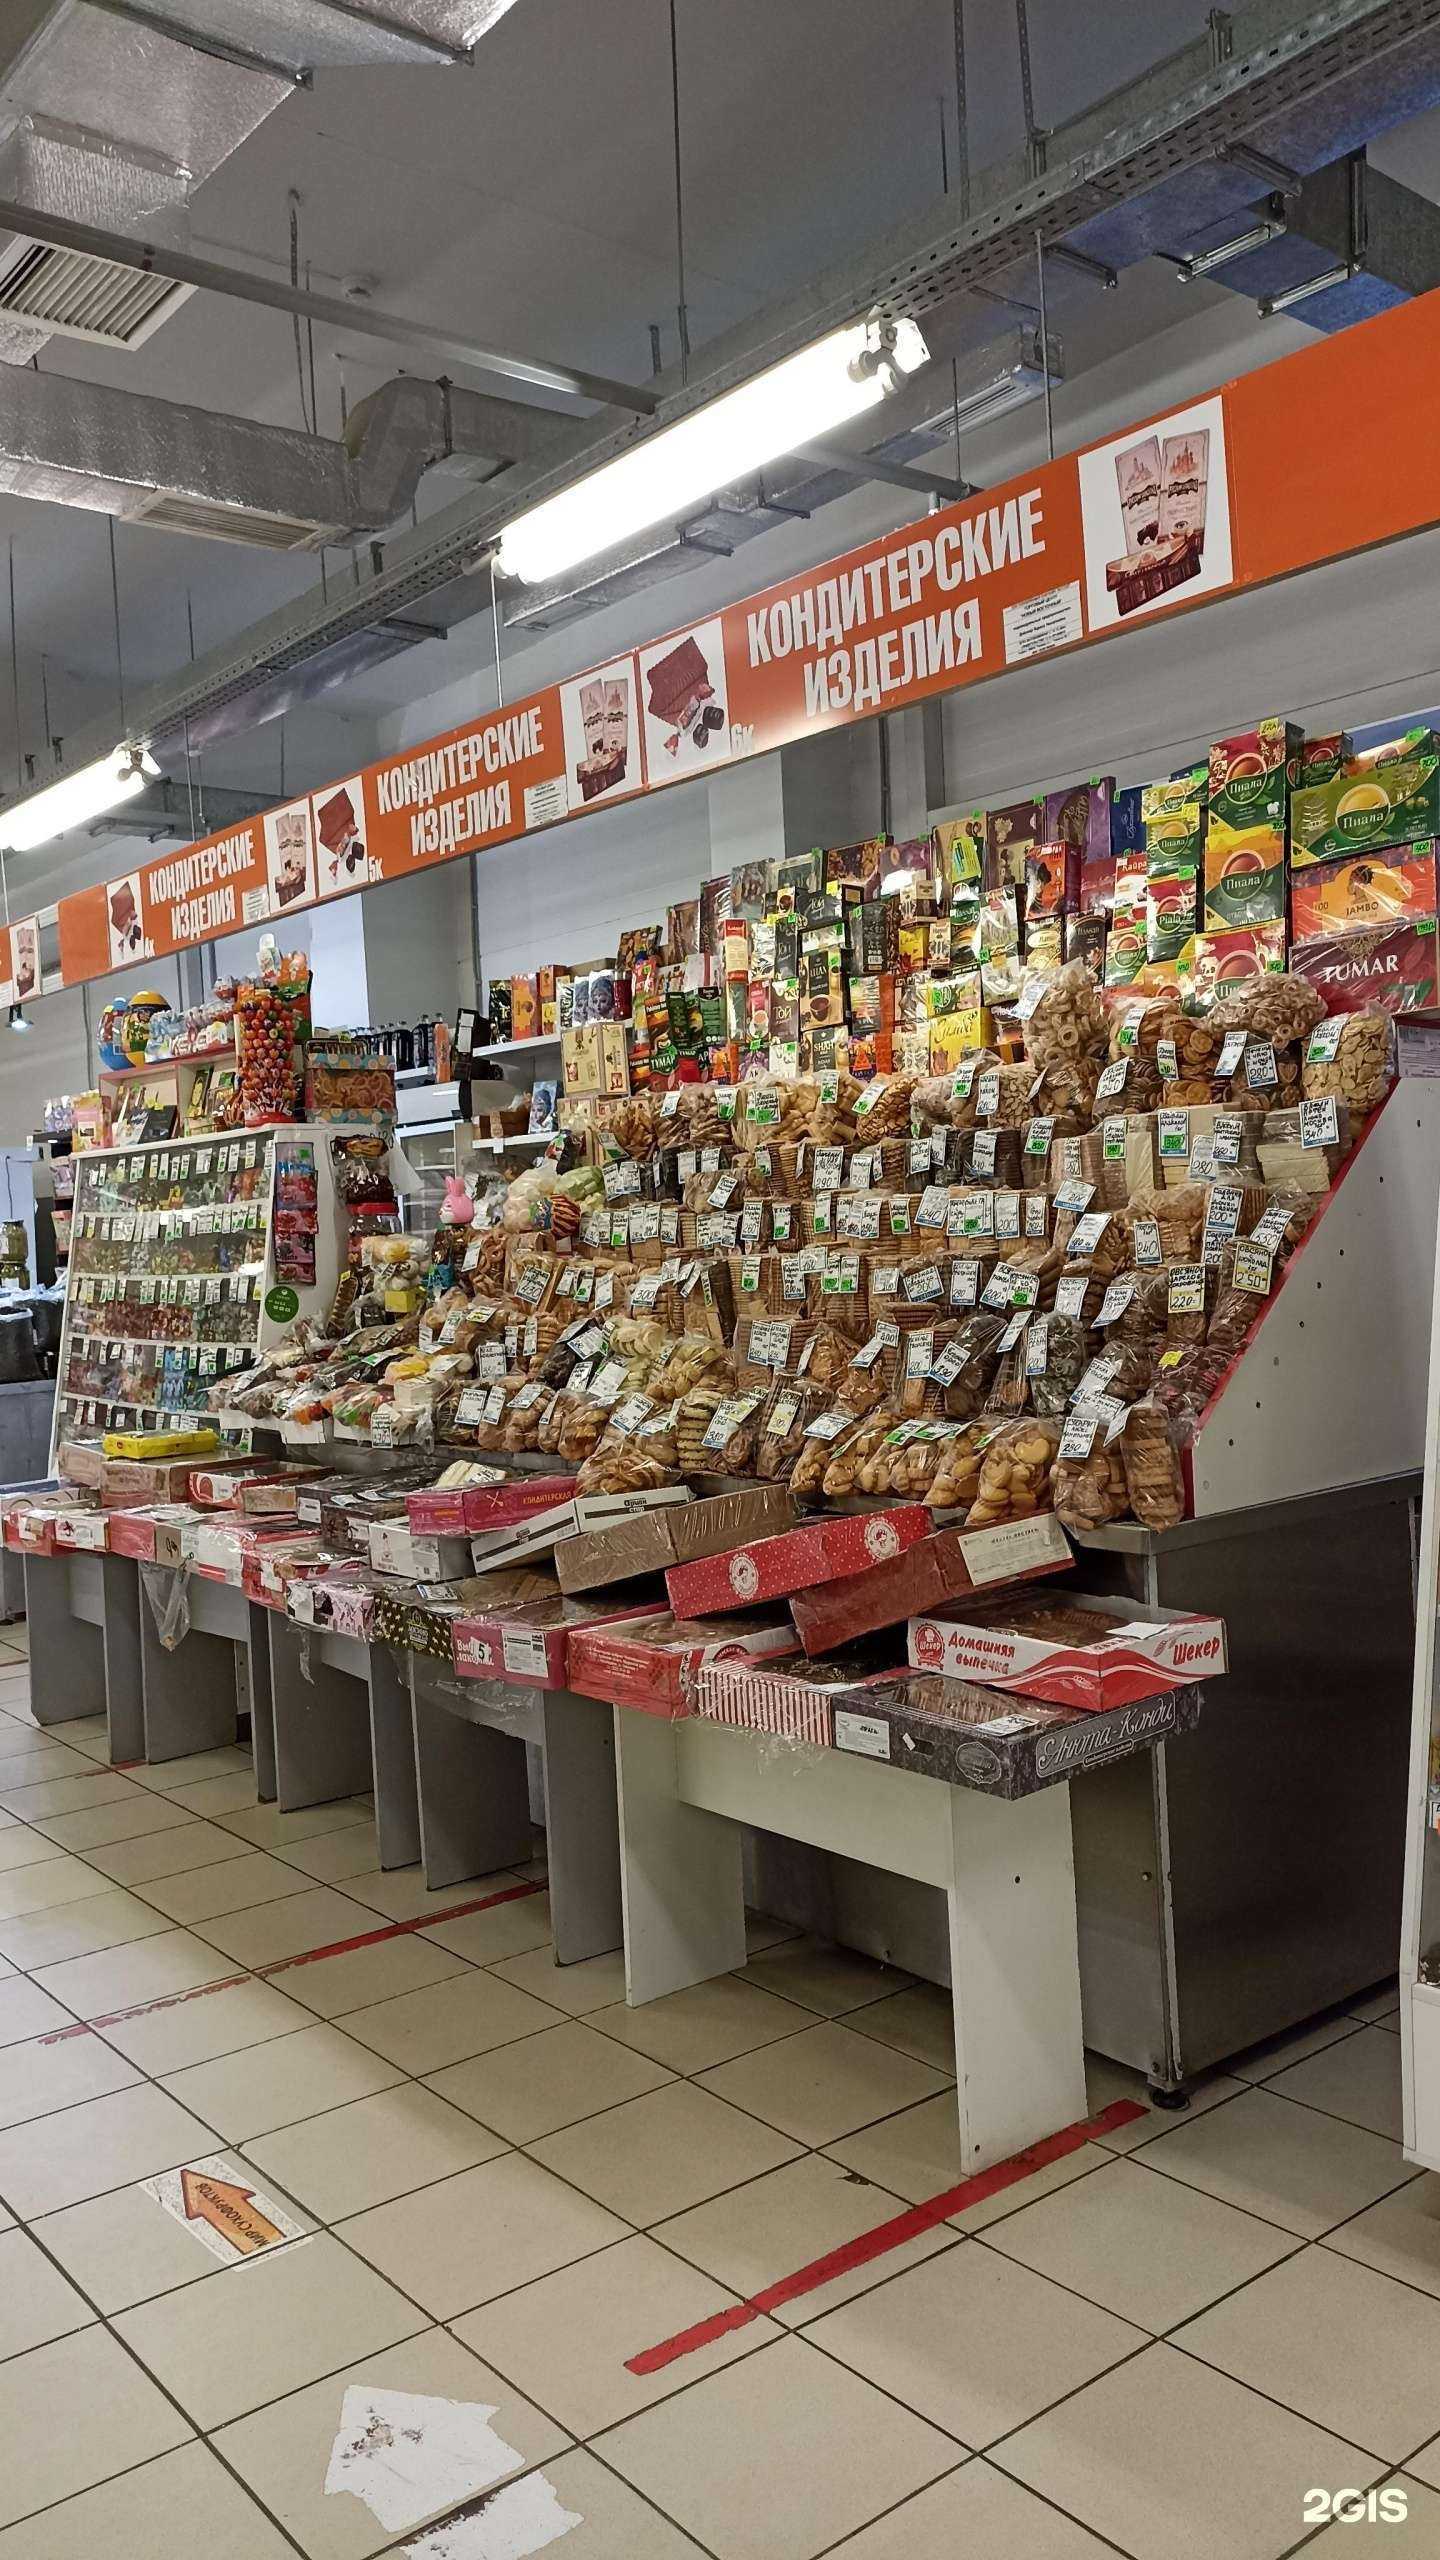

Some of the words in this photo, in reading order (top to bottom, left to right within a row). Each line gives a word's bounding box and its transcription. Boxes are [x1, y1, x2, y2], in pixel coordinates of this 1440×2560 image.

[747, 488, 1046, 667] КОНДИТЕРСКИЕ
[803, 598, 983, 718] ИЗДЕЛИЯ
[377, 706, 545, 815] КОНДИТЕРСКИЕ
[1230, 780, 1262, 794] Пиала
[410, 780, 512, 856] ИЗДЕЛИЯ
[1343, 812, 1384, 829] Пиала
[148, 829, 256, 906] КОНДИТЕРСКИЕ
[1226, 876, 1260, 891] Пиала
[171, 884, 236, 941] ИЗДЕЛИЯ
[1346, 902, 1380, 916] JAMBO
[1323, 954, 1400, 983] TUMAR
[651, 1055, 676, 1069] ТУМАР
[948, 1631, 1016, 1659] Домашняя
[1172, 1636, 1220, 1666] Шекер
[956, 1653, 1009, 1675] выпечка
